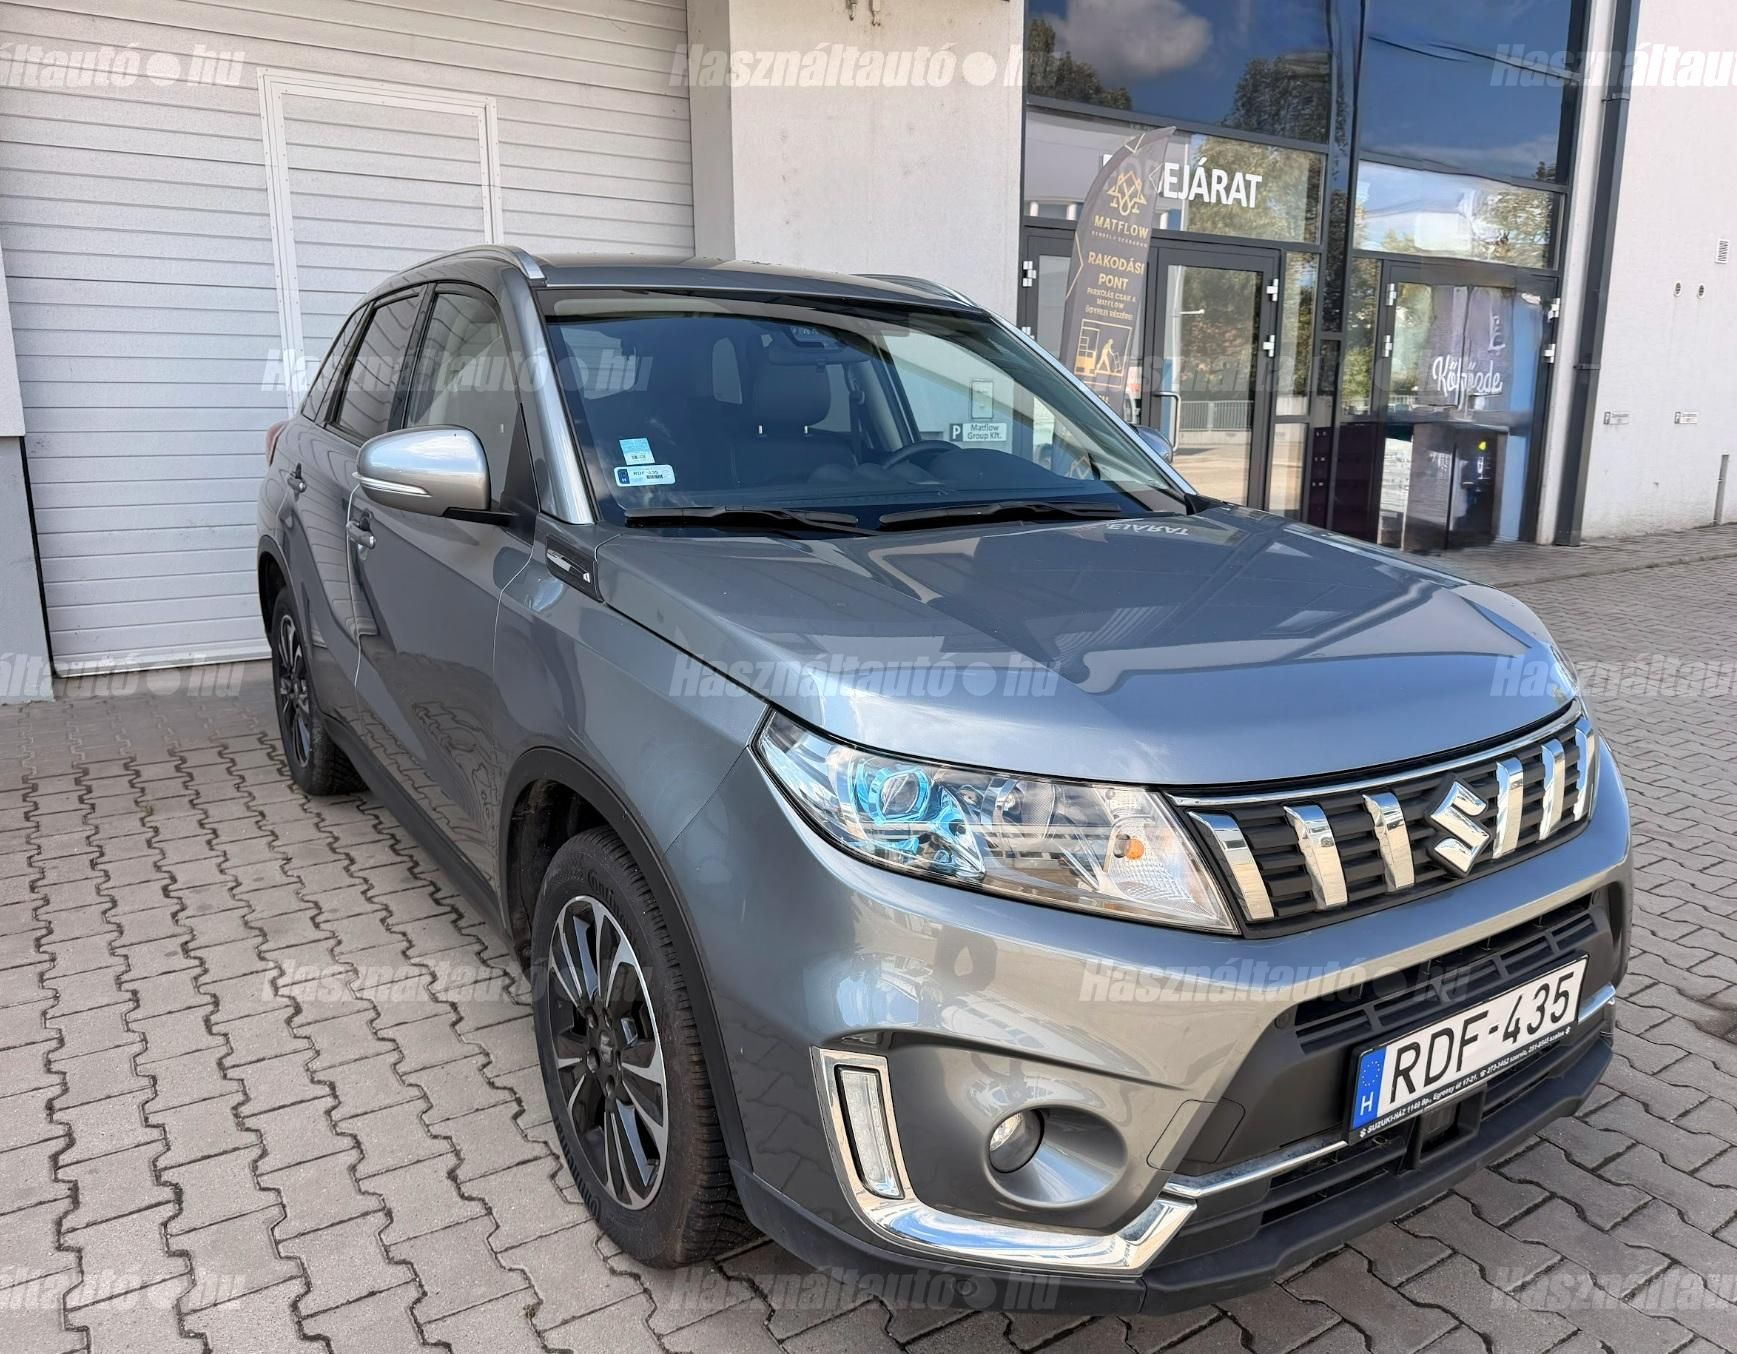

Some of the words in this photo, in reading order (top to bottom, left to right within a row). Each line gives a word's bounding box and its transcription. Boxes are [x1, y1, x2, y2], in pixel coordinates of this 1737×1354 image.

[1094, 215, 1149, 239] MATFLOW
[1087, 251, 1145, 275] RAKODÁSI
[1098, 273, 1129, 290] PONT
[952, 425, 961, 440] P
[1389, 971, 1575, 1104] RDF-435
[1360, 1091, 1374, 1116] H
